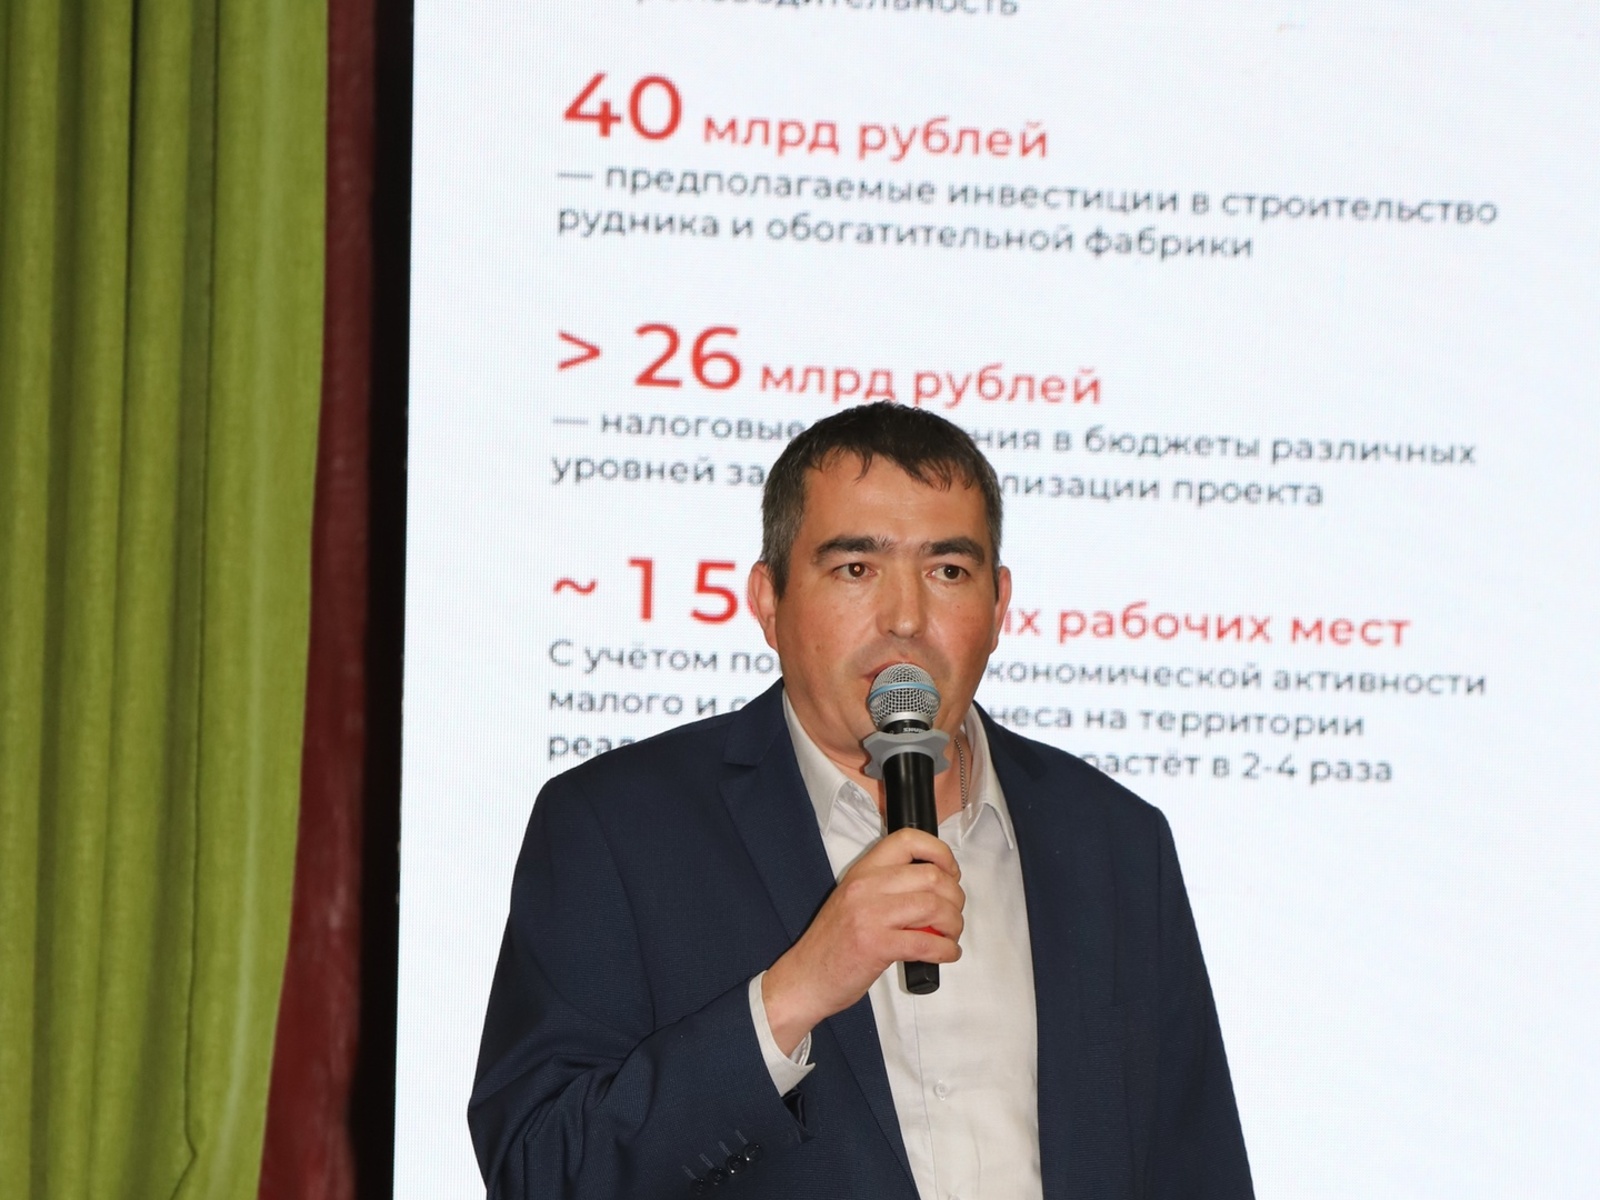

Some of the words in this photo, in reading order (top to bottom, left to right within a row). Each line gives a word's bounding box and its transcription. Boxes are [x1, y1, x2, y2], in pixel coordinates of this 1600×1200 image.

[562, 72, 684, 142] 40
[703, 116, 840, 156] млрд
[858, 117, 1048, 163] рублей
[606, 166, 936, 204] предполагаемые
[948, 184, 1179, 214] инвестиции
[1191, 193, 1209, 215] в
[1221, 194, 1498, 224] строительство
[558, 208, 720, 238] рудника
[731, 218, 753, 238] и
[766, 213, 1074, 251] обогатительной
[1085, 226, 1253, 261] фабрики
[634, 322, 743, 391] 26
[760, 365, 897, 403] млрд
[913, 364, 1101, 405] рублей
[1054, 430, 1072, 452] в
[1084, 425, 1260, 458] бюджеты
[1271, 439, 1474, 466] различных
[552, 457, 715, 485] уровней
[1173, 479, 1323, 507] проекта
[627, 557, 655, 623] 1
[690, 559, 756, 625] 5
[1058, 601, 1270, 644] рабочих
[1291, 618, 1411, 648] мест
[548, 640, 573, 667] С
[584, 645, 718, 674] учётом
[1273, 670, 1486, 696] активности
[549, 691, 683, 715] малого
[696, 696, 717, 717] и
[1085, 709, 1127, 730] на
[1140, 710, 1364, 740] территории
[1212, 756, 1230, 778] в
[1242, 751, 1297, 779] 2-4
[1310, 760, 1393, 786] раза
